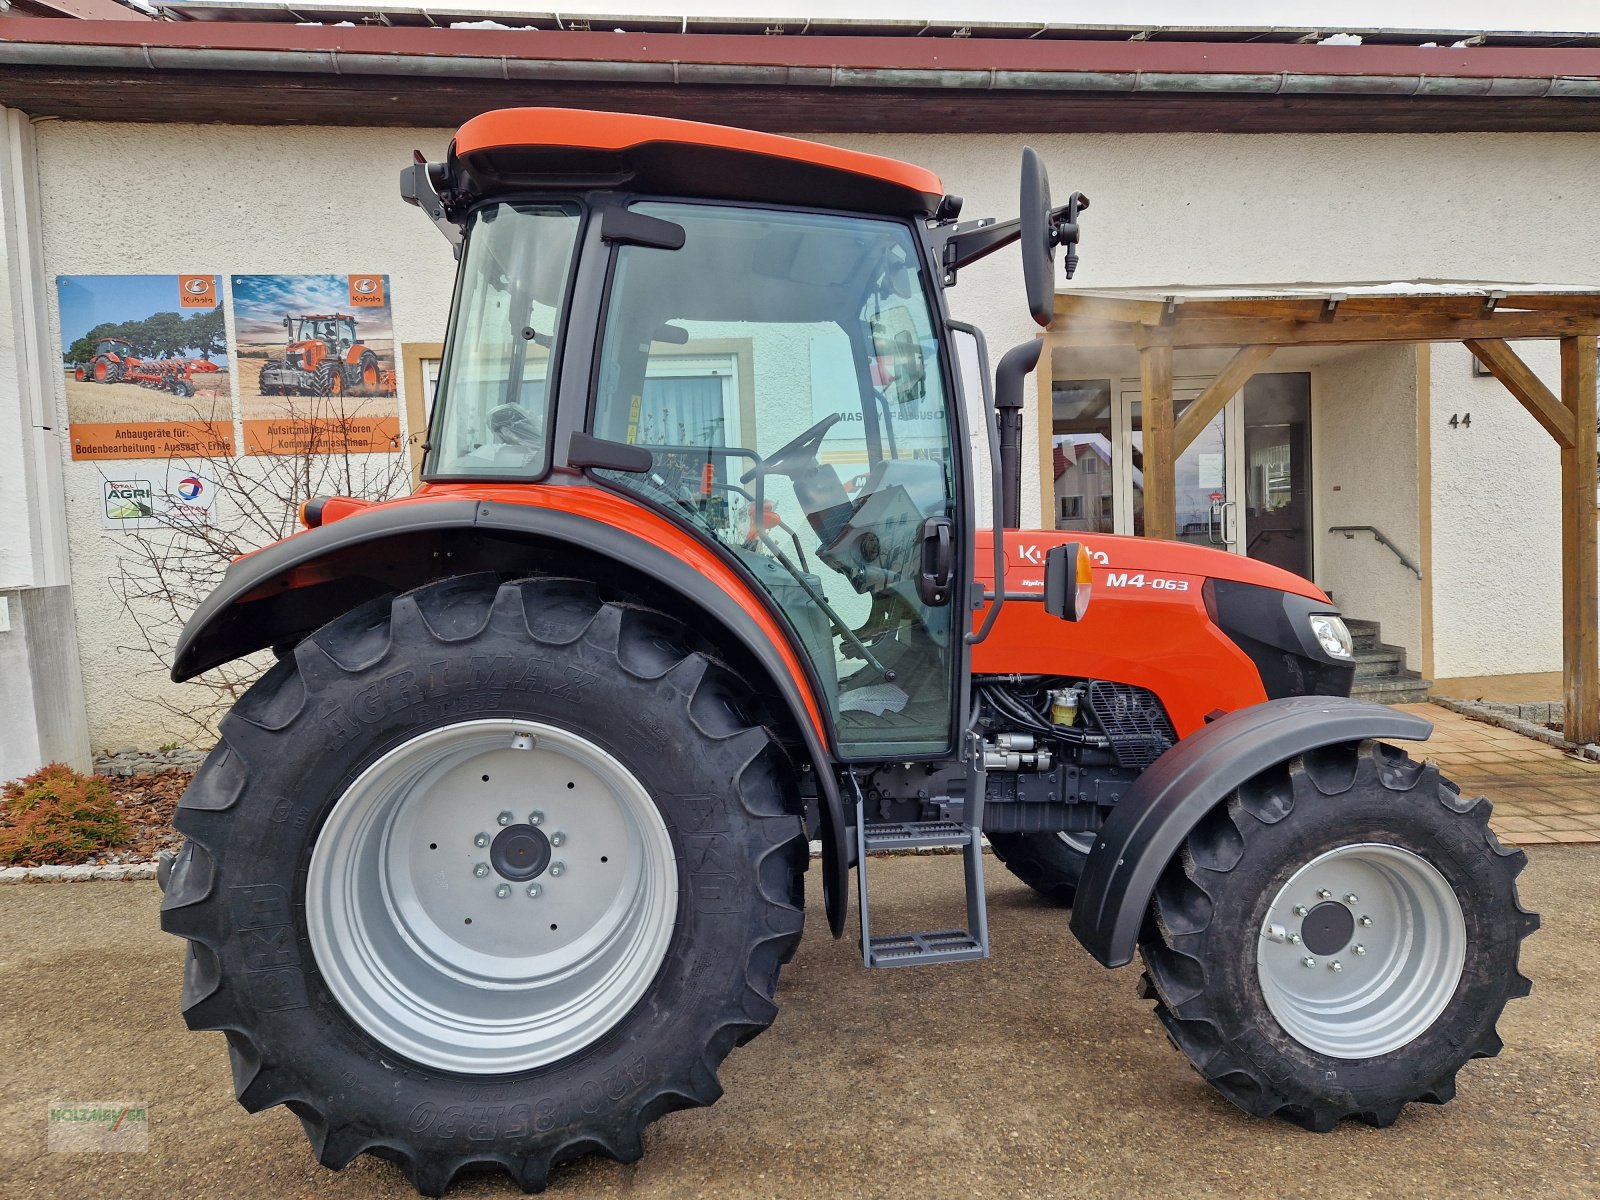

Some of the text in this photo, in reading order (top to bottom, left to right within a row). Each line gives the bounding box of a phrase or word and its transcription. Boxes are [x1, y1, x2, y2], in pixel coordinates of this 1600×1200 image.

[183, 296, 214, 304] Kubota
[352, 295, 382, 303] Kubota
[838, 411, 883, 422] MASY
[115, 428, 190, 440] Anbaugeräte für:
[75, 443, 156, 455] Bodenbearbeitung
[164, 442, 200, 452] Aussaat
[107, 489, 150, 500] AGRI
[1106, 573, 1189, 591] M4-063
